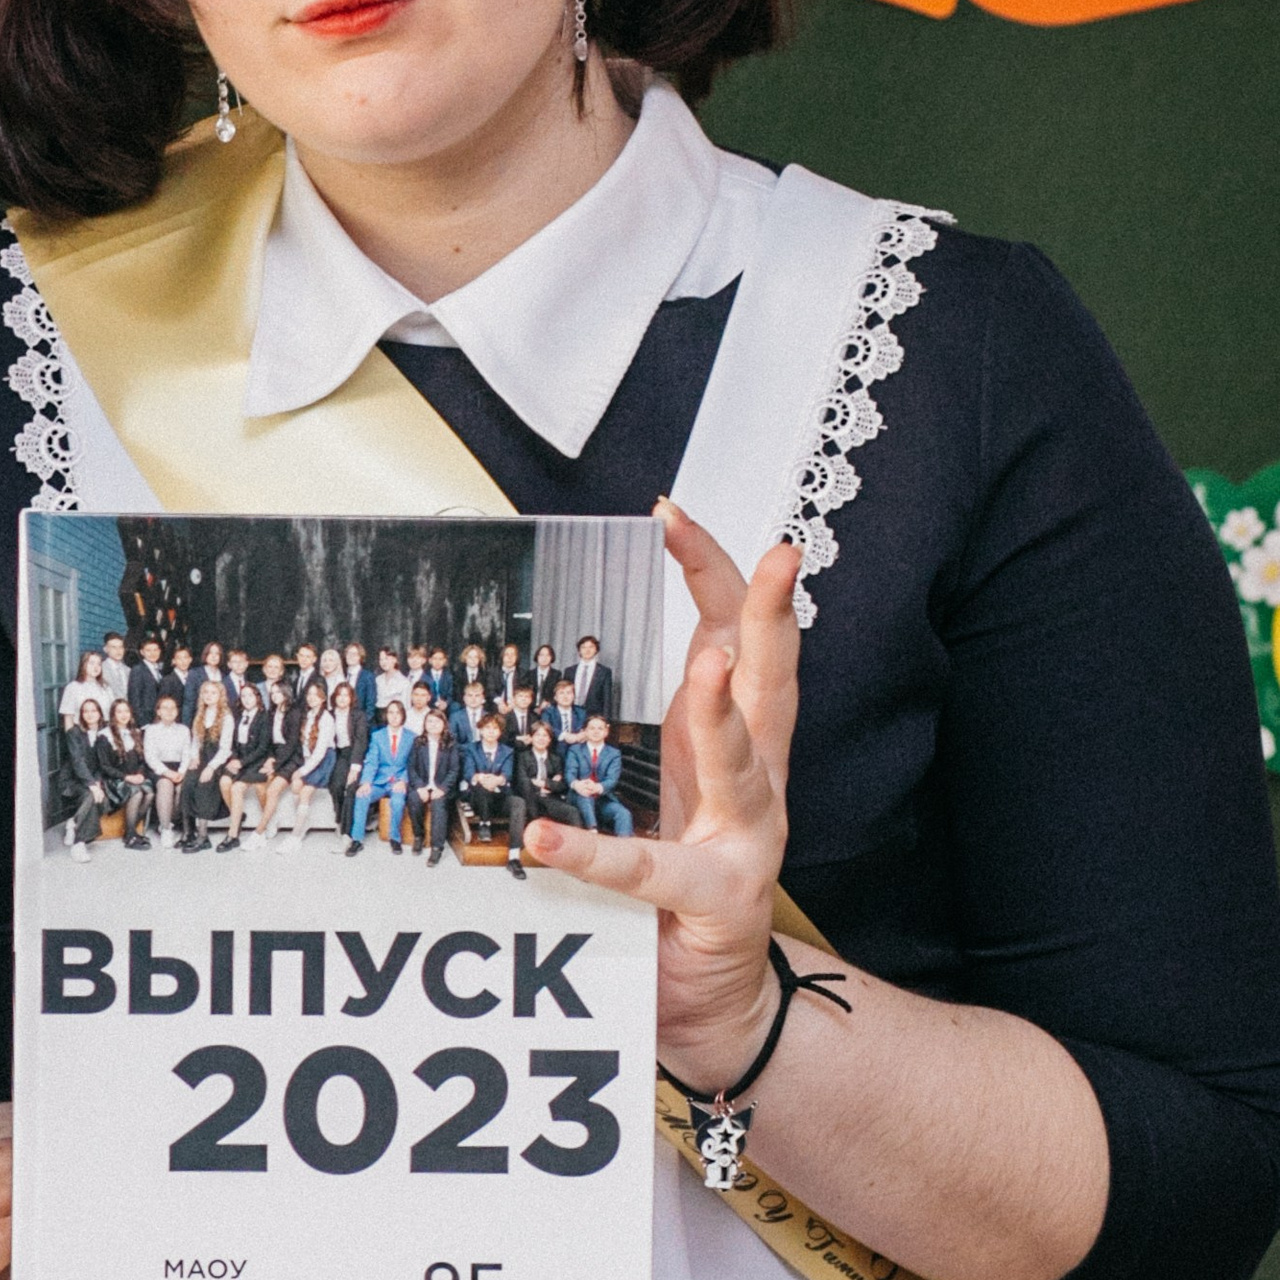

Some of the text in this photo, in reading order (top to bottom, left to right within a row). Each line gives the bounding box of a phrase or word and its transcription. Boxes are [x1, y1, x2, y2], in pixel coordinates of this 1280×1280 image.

[41, 928, 594, 1020] ВЫПУСК
[168, 1045, 621, 1178] 2023
[164, 1260, 248, 1280] МАОУ
